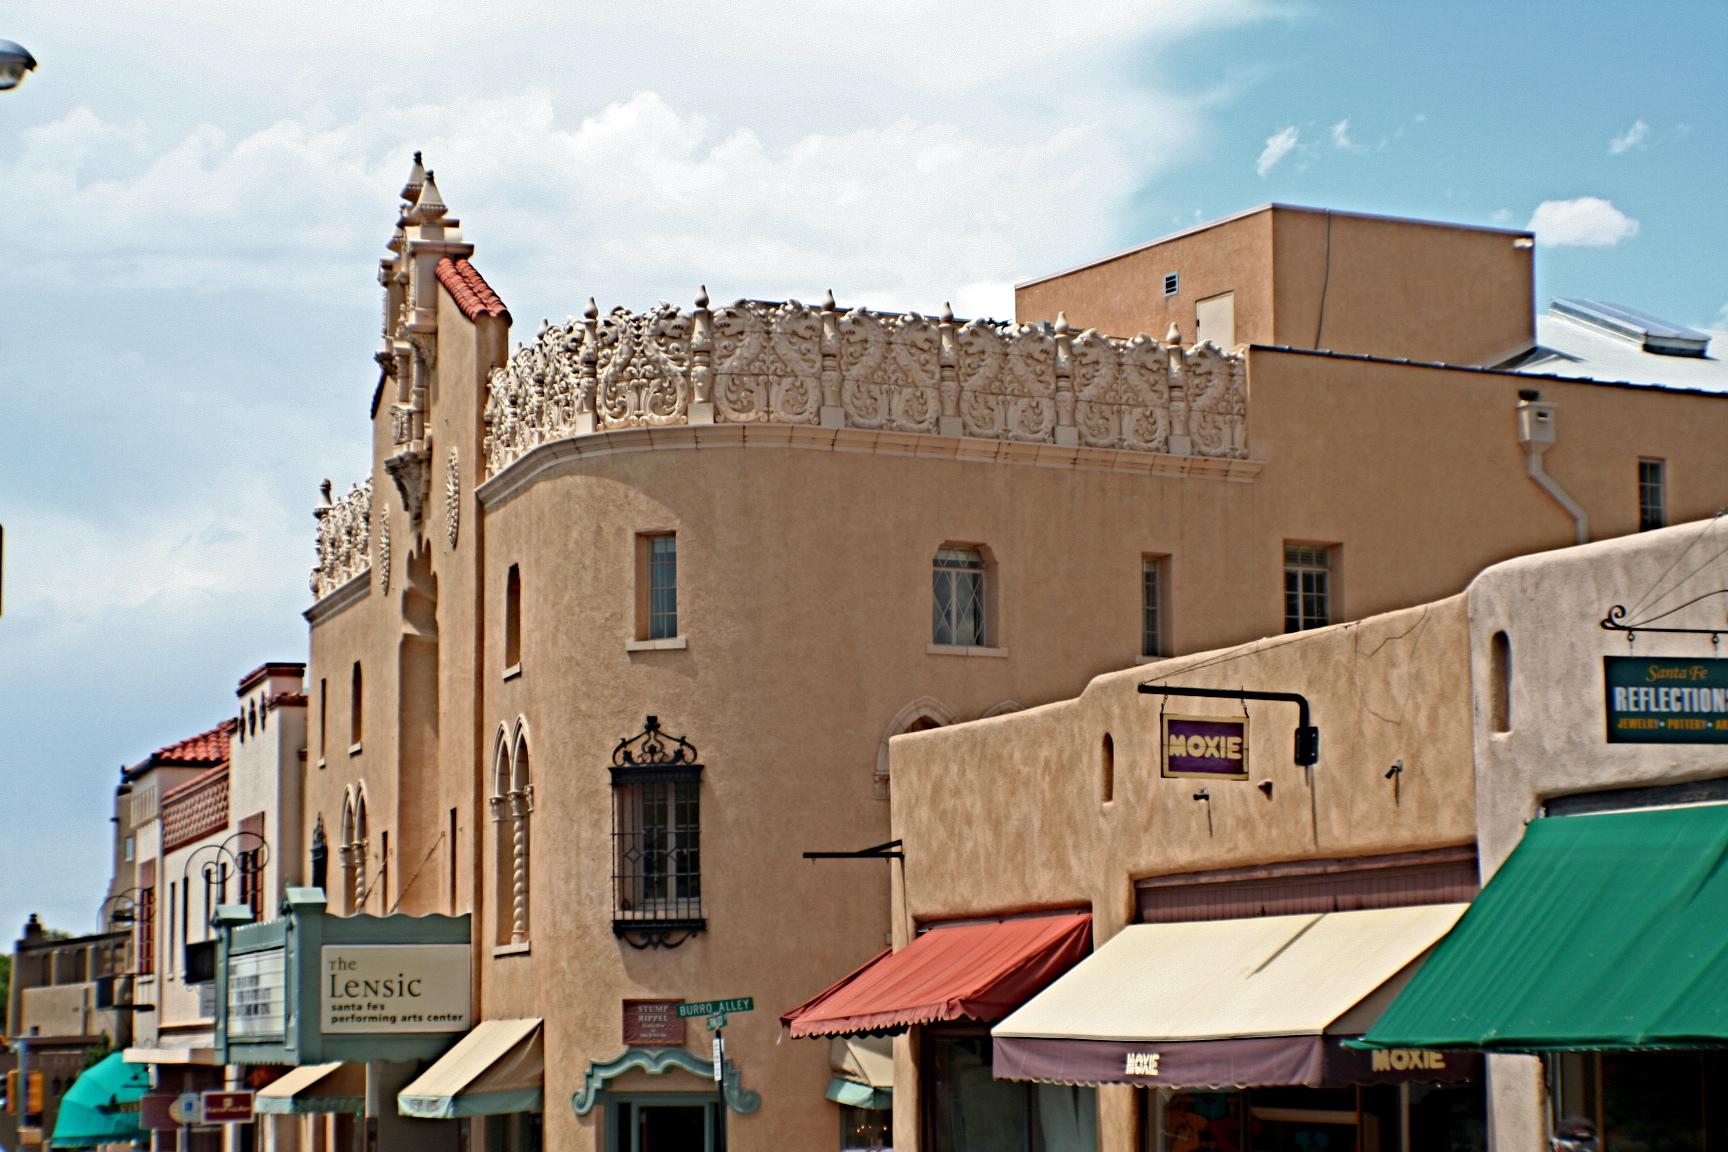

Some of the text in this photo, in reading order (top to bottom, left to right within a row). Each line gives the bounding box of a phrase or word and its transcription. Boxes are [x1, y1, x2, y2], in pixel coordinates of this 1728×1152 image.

[1646, 665, 1709, 682] Santa Fe
[1613, 687, 1728, 712] REFLECTION
[1169, 734, 1242, 760] MOXIE
[331, 1003, 362, 1011] santa
[679, 999, 750, 1017] BURRO ALLEY
[331, 1013, 464, 1024] performing arts center
[1125, 1053, 1160, 1076] MOXIE
[1372, 1048, 1446, 1072] MOXIE
